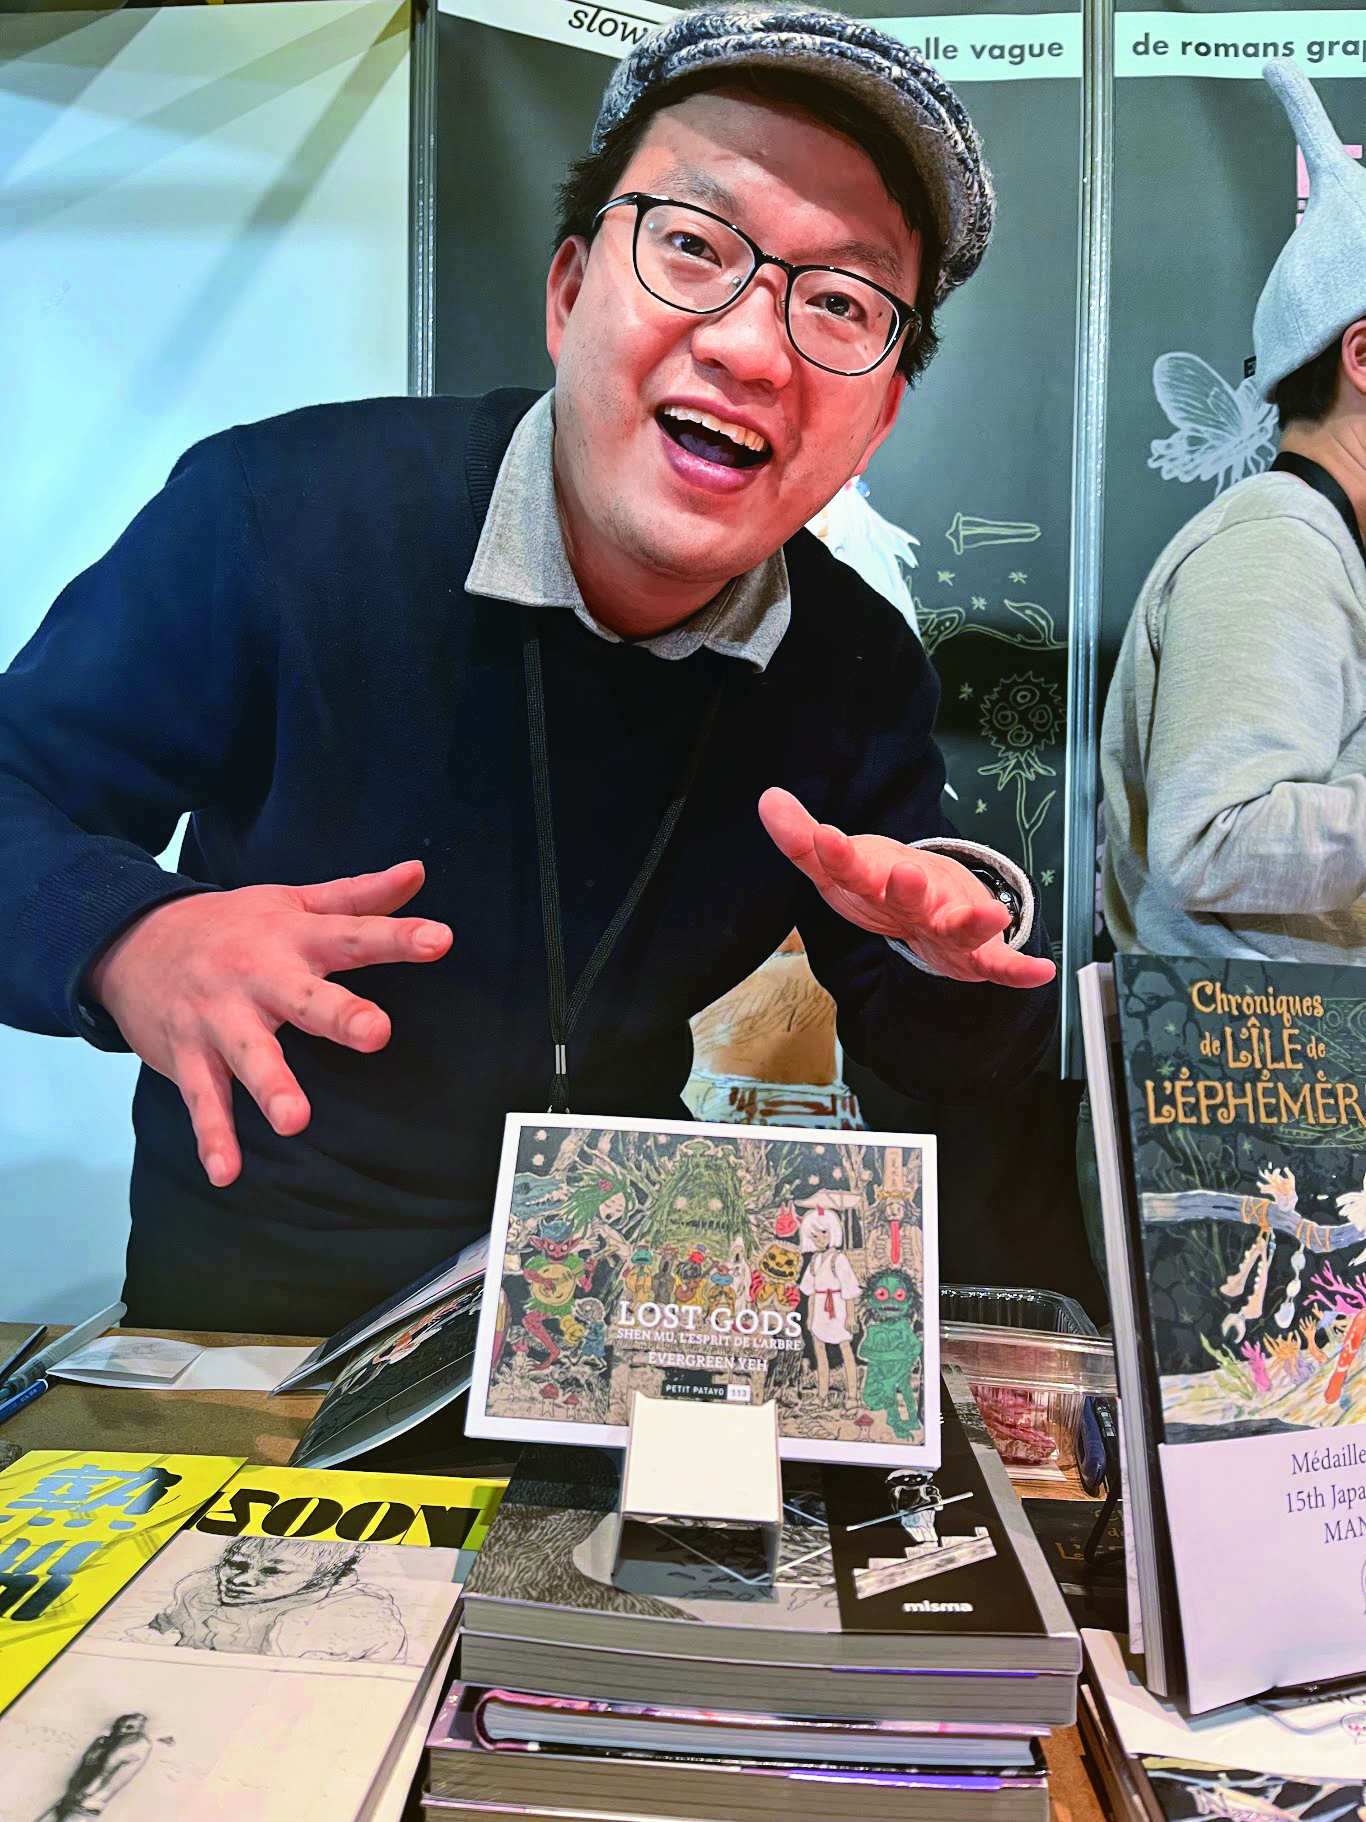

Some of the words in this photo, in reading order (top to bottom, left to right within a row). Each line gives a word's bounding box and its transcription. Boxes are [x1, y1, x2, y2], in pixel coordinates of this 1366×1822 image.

[970, 41, 1064, 66] vague
[1132, 32, 1169, 56] de
[1181, 40, 1295, 58] romans
[1306, 39, 1366, 64] gra
[1191, 980, 1325, 1026] Chroniques
[1200, 1032, 1221, 1057] de
[1307, 1035, 1326, 1060] de
[617, 1300, 702, 1330] LOST
[710, 1307, 802, 1338] GODS
[616, 1328, 651, 1341] SHEN
[654, 1331, 677, 1344] MU,
[680, 1332, 730, 1347] L'ESPRIT
[733, 1336, 751, 1348] DE
[752, 1337, 802, 1351] L'ARBRE
[648, 1351, 734, 1369] EVERGREEN
[738, 1358, 768, 1372] YEH
[665, 1383, 691, 1394] PETIT
[1291, 1443, 1366, 1475] Médaille
[1286, 1486, 1326, 1513] 15th
[902, 1599, 974, 1612] misma
